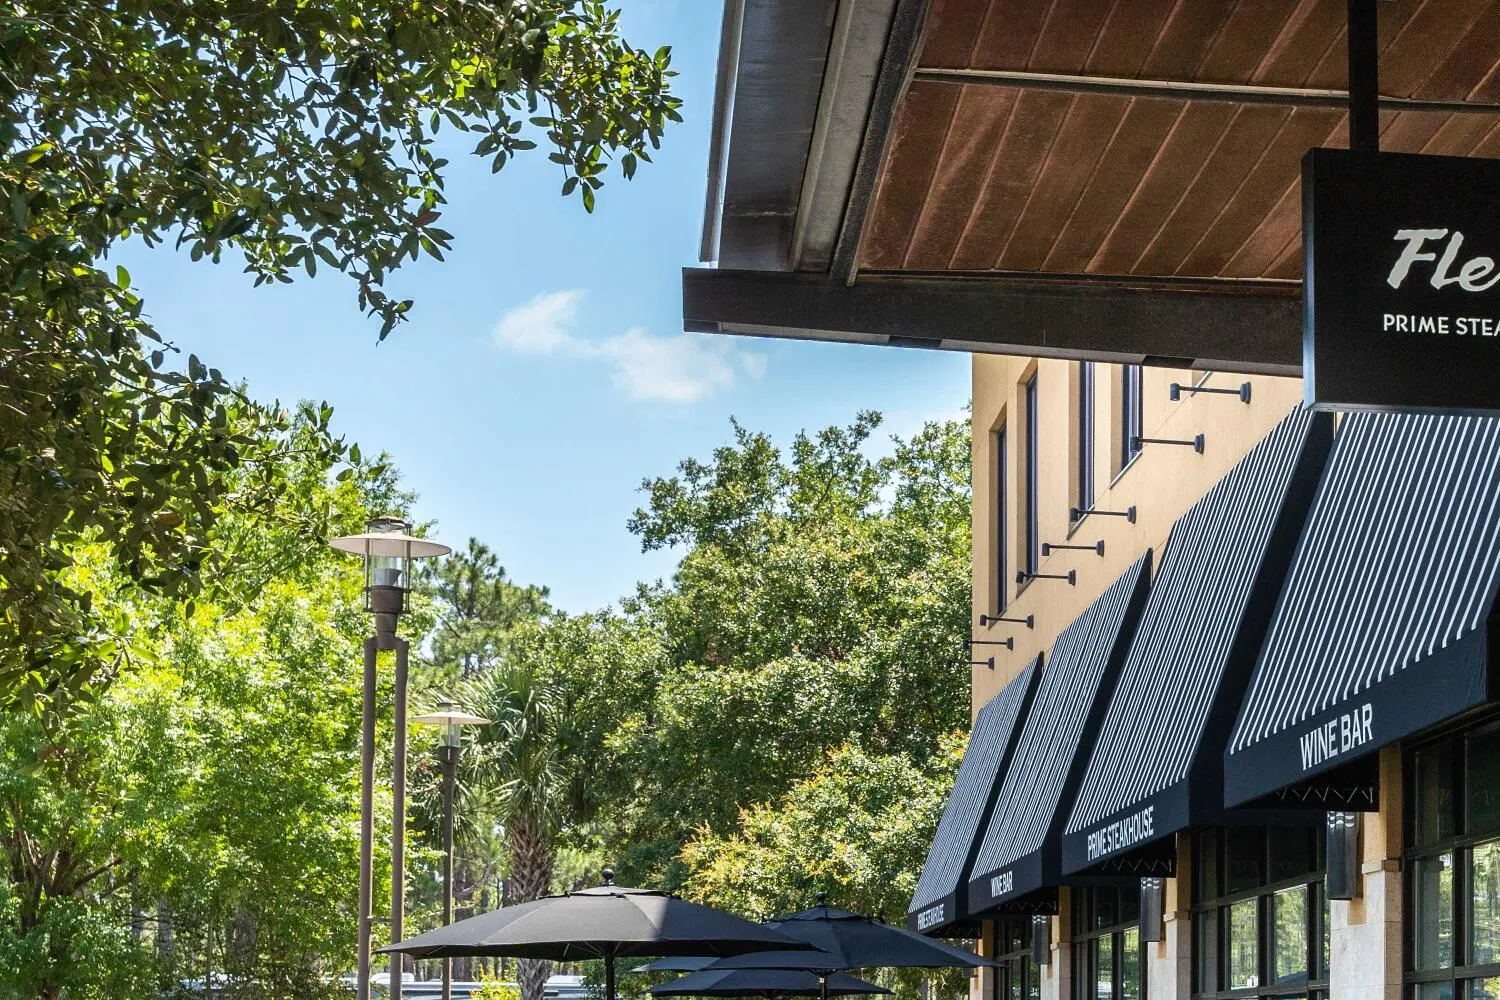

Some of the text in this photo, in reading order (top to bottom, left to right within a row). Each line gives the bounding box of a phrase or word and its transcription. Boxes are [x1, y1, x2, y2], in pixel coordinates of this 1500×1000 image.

[1384, 314, 1449, 334] PRIME
[1300, 703, 1373, 770] WINE BAR
[1088, 805, 1153, 861] PRIME STEAKHOUSE
